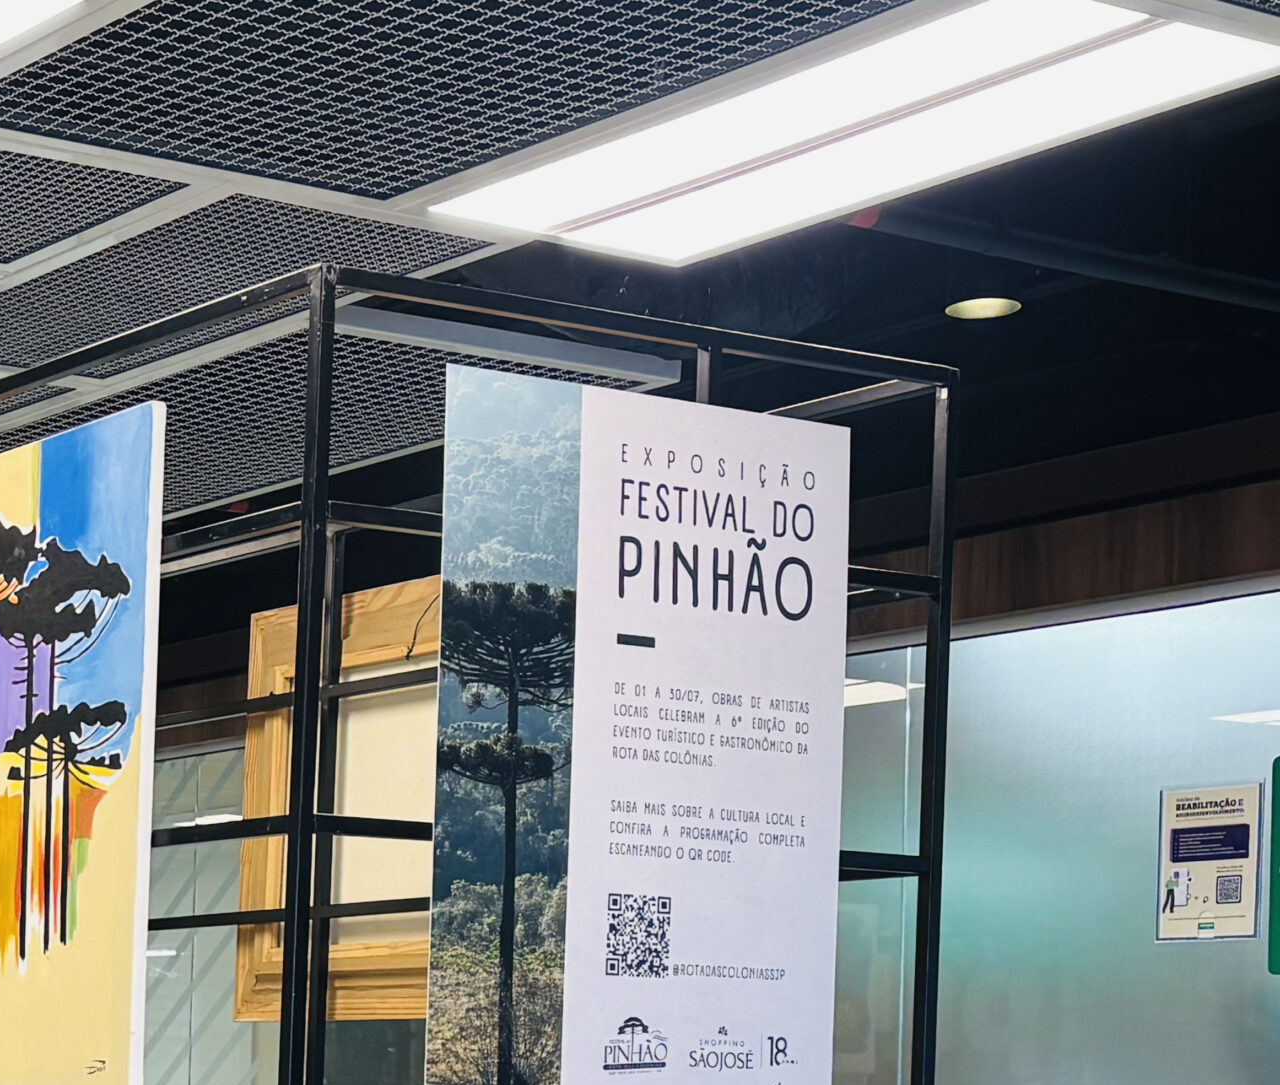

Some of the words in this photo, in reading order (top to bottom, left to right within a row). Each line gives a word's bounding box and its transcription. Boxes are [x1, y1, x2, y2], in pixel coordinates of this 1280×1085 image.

[621, 443, 815, 490] EXPOSIÇÃO
[620, 478, 755, 534] FESTIVAL
[773, 501, 814, 542] DO
[618, 535, 813, 621] PINHÃO
[614, 682, 626, 695] DE
[634, 684, 646, 697] 01
[654, 686, 661, 699] A
[669, 688, 704, 704] 30/07,
[712, 692, 743, 707] OBRAS
[750, 696, 761, 709] DE
[769, 698, 810, 714] ARTISTAS
[613, 703, 648, 719] LOCAIS
[658, 708, 705, 723] CELEBRAM
[715, 713, 721, 725] A
[752, 717, 786, 733] EDIÇÃO
[795, 722, 809, 735] DO
[613, 724, 652, 740] EVENTO
[656, 727, 705, 746] TURÍSTICO
[710, 734, 715, 746] E
[719, 735, 793, 754] GASTRONÔMICO
[797, 742, 808, 755] DA
[612, 746, 638, 760] ROTA
[642, 748, 660, 762] DAS
[664, 750, 717, 767] COLÔNIAS.
[610, 799, 637, 813] SAIBA
[644, 802, 666, 816] MAIS
[671, 804, 703, 819] SOBRE
[708, 807, 714, 819] A
[720, 808, 760, 824] CULTURA
[765, 812, 795, 827] LOCAL
[800, 815, 805, 827] E
[1176, 798, 1237, 811] REABILITAÇÃO
[609, 821, 652, 836] CONFIRA
[662, 825, 669, 837] A
[680, 826, 748, 845] PROGRAMAÇÃO
[758, 832, 805, 848] COMPLETA
[609, 842, 672, 859] ESCANEANDO
[675, 847, 684, 860] O
[688, 848, 703, 861] QR
[706, 849, 735, 863] CODE.
[604, 1039, 668, 1064] PINHÃO
[699, 1039, 745, 1047] SHOPPING
